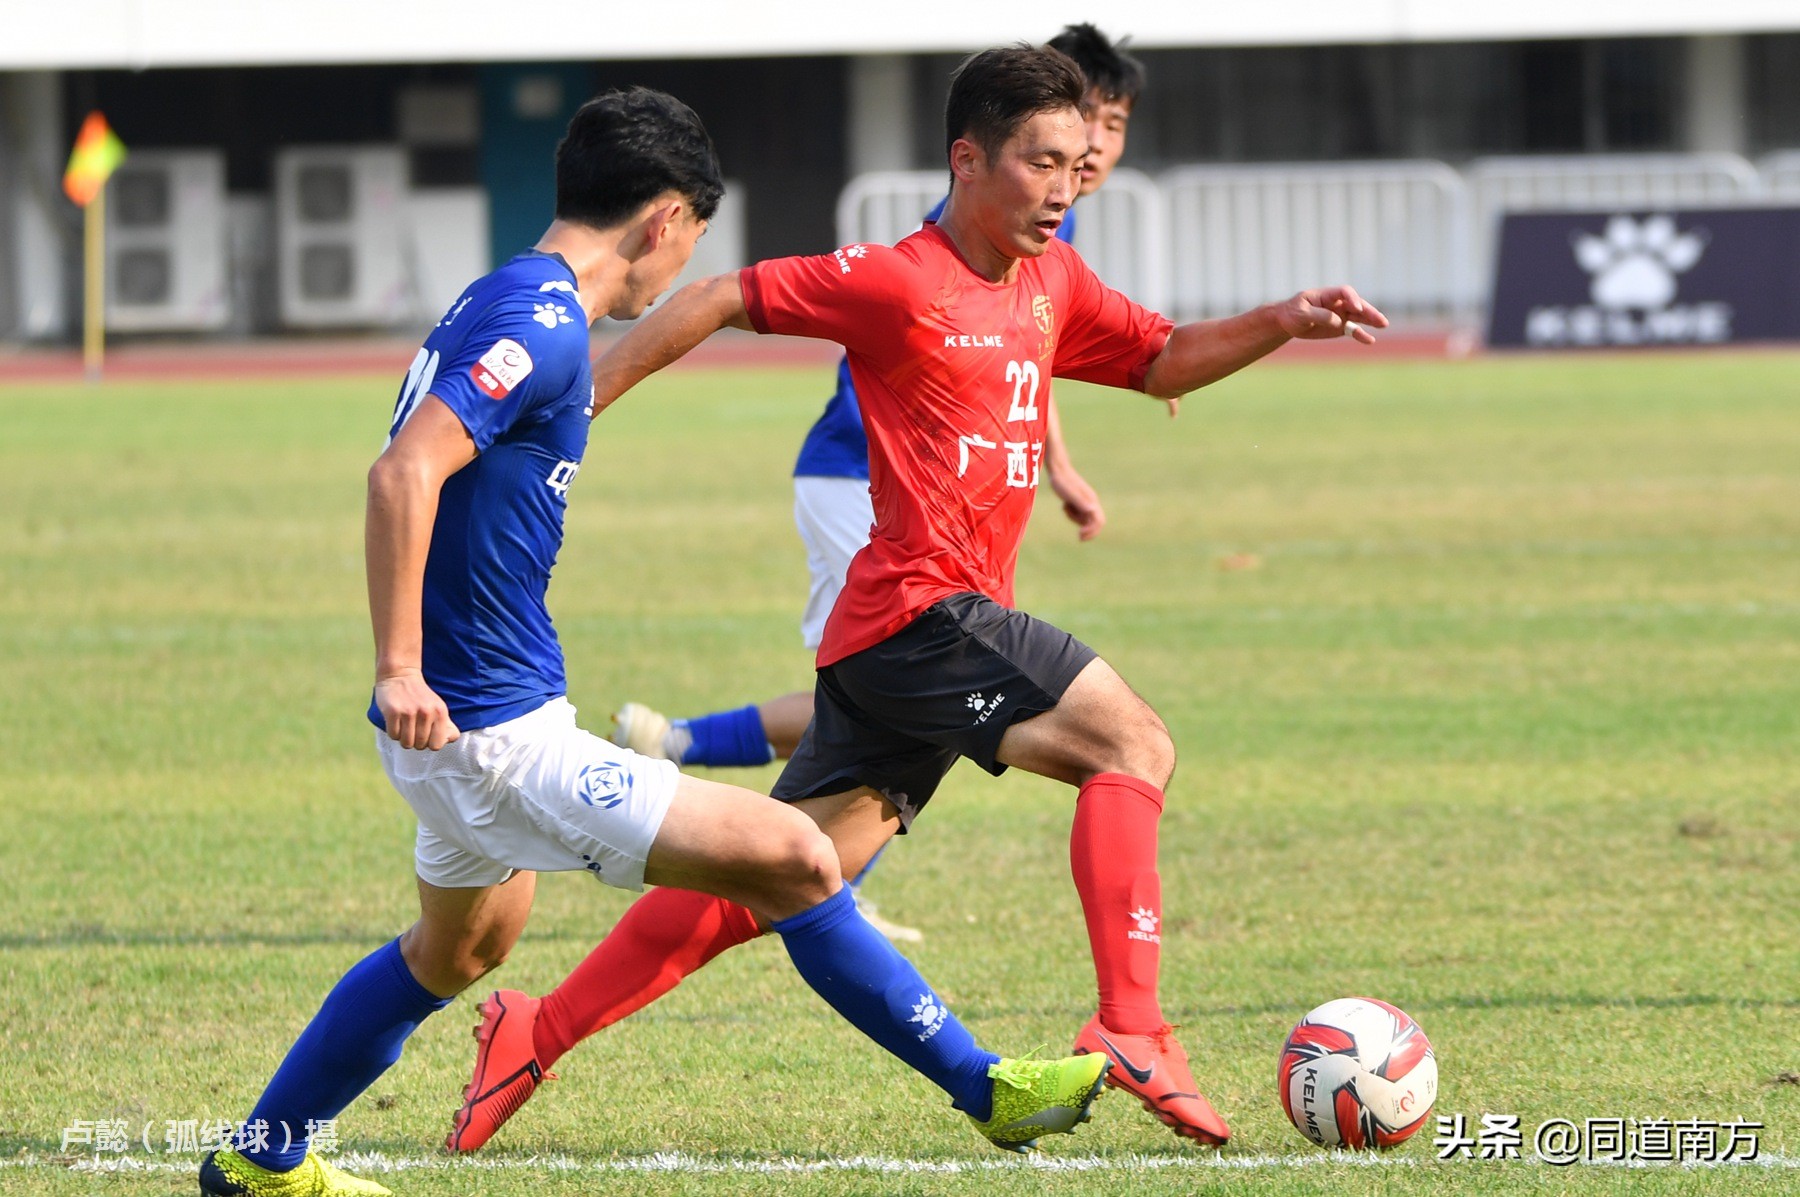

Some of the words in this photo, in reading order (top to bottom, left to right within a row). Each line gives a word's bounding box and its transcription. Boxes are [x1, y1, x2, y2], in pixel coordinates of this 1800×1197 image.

[944, 335, 1004, 348] KELME
[1525, 303, 1731, 345] KELME
[1005, 360, 1040, 422] 22
[1303, 1067, 1323, 1140] KELME
